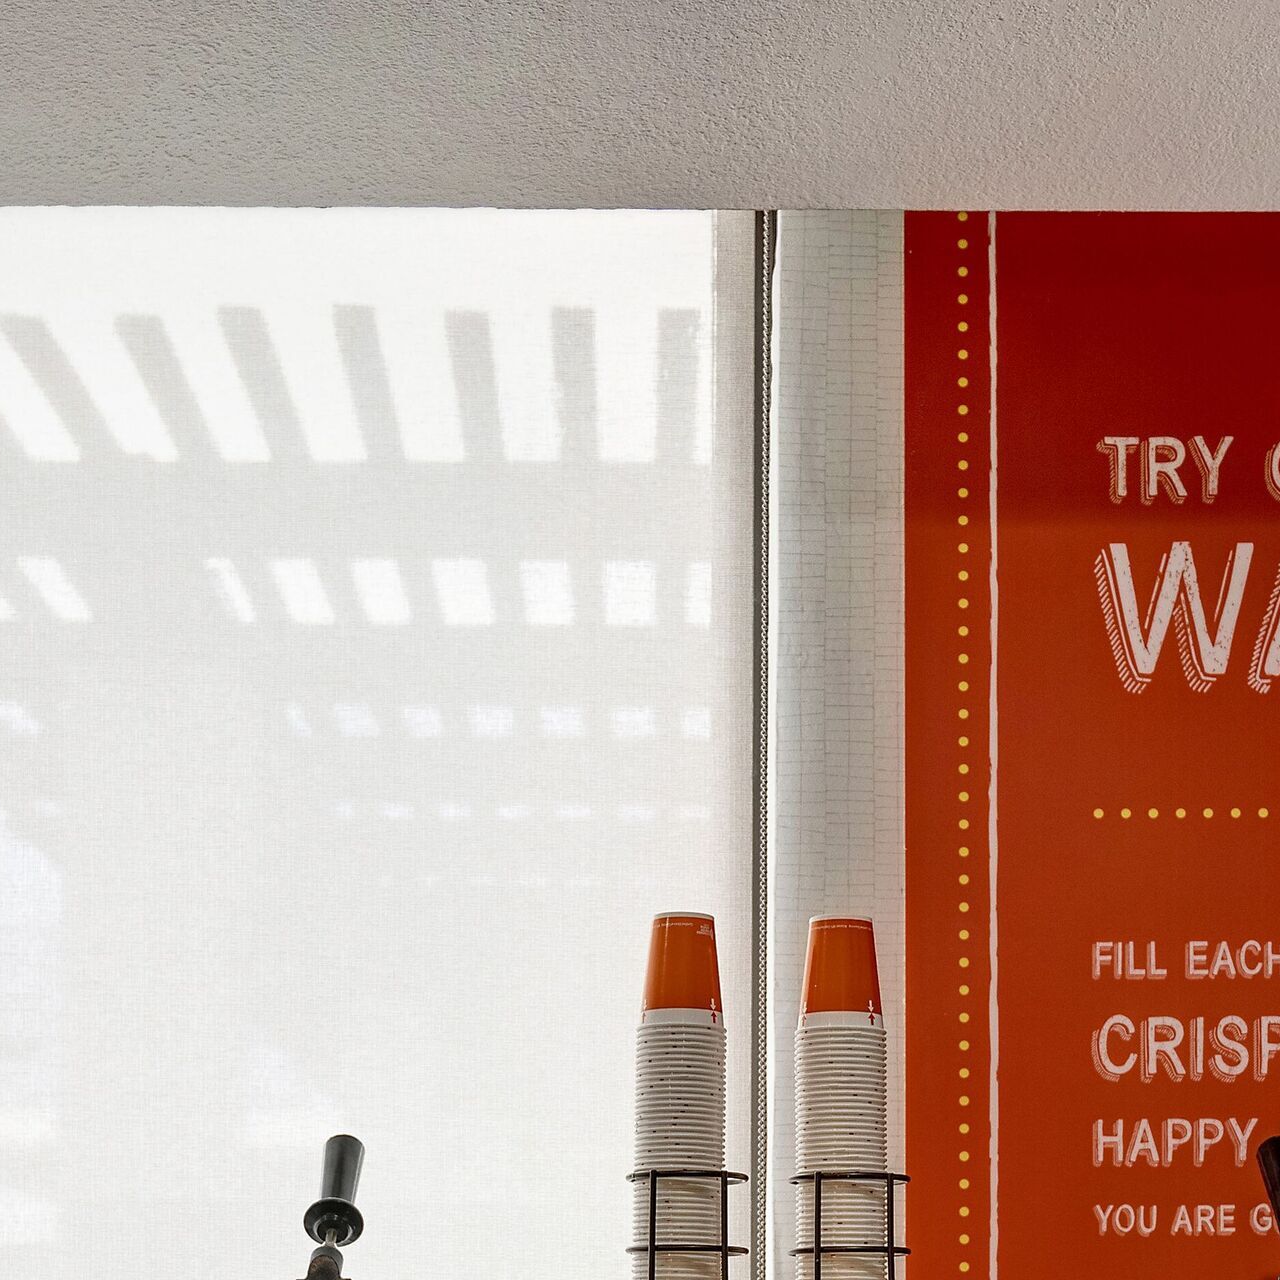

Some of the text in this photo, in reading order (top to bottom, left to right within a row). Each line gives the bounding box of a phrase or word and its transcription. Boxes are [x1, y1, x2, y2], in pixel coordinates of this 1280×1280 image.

[1096, 435, 1233, 505] TRY
[1092, 941, 1168, 980] FILL
[1092, 1117, 1258, 1168] HAPPY
[1095, 1203, 1158, 1236] YOU
[1171, 1203, 1236, 1235] ARE
